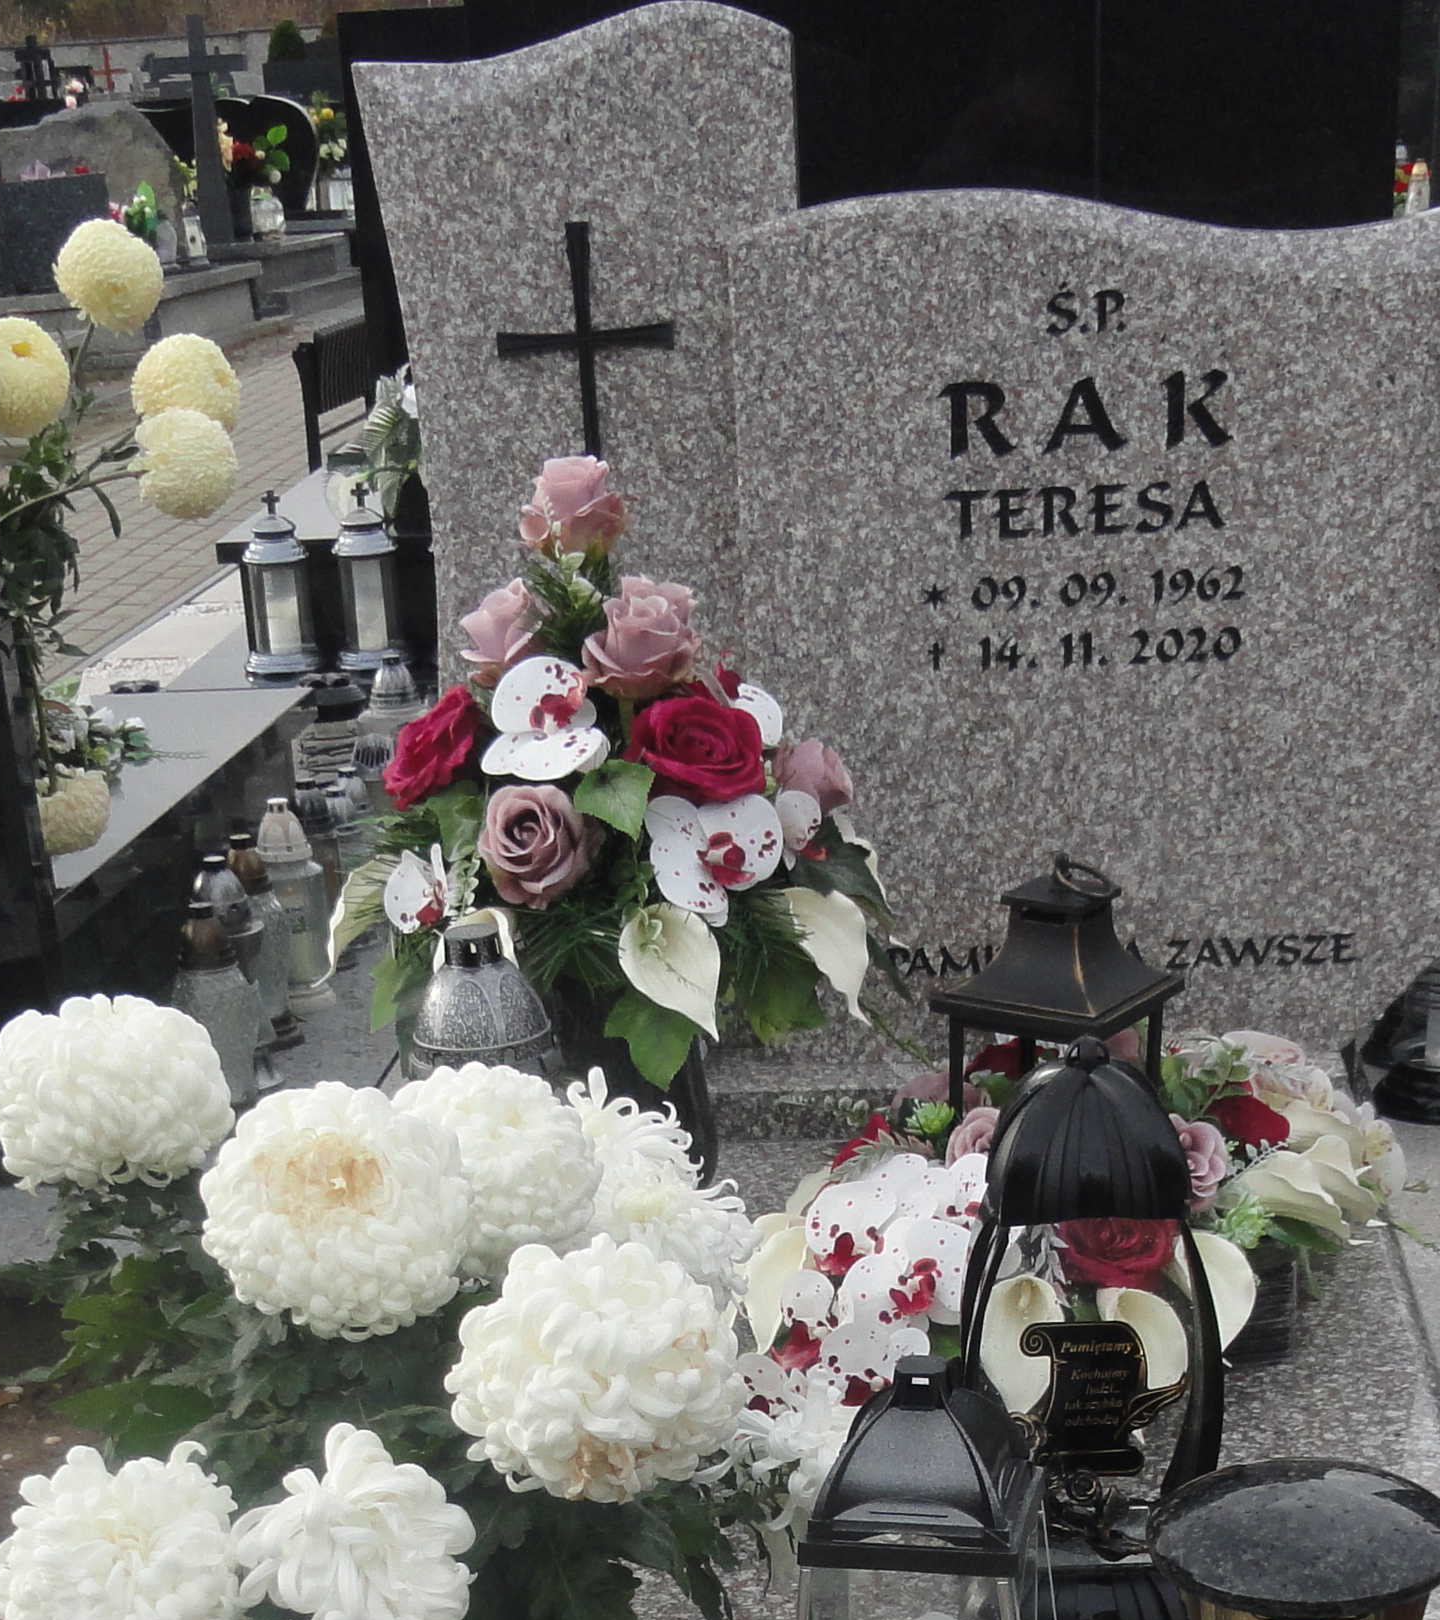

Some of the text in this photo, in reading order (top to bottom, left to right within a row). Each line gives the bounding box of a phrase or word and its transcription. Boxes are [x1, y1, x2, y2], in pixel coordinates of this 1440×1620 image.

[937, 368, 1234, 460] RAK
[944, 480, 1227, 540] TERESA
[971, 564, 1246, 612] 09. 09. 1962
[978, 626, 1243, 672] 14. 11. 2020
[1166, 932, 1358, 972] ZAWSZE
[1060, 1340, 1134, 1355] Pamiętamy
[1070, 1368, 1130, 1381] Kochajmy
